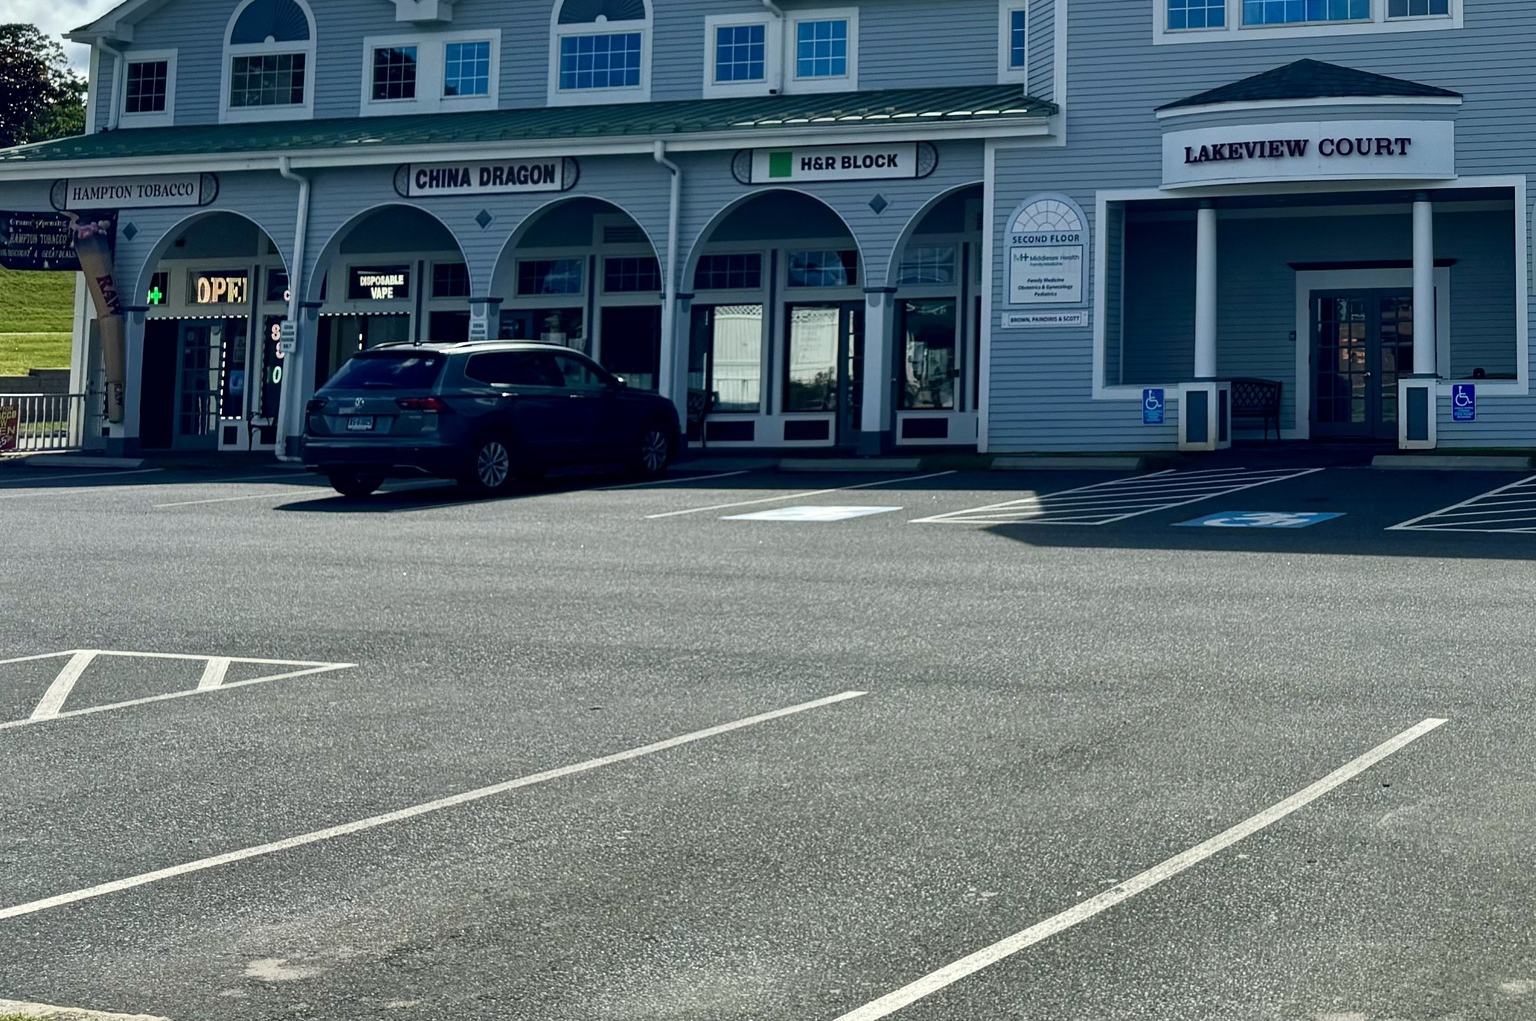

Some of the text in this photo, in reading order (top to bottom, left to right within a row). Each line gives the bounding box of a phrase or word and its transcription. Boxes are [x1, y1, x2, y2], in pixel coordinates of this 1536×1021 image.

[1184, 137, 1412, 165] LAKEVIEW COURT
[801, 154, 898, 171] H&R BLOCK
[415, 164, 556, 189] CHINA DRAGON
[72, 182, 194, 201] HAMPTON TOBACCO
[1012, 234, 1080, 244] SECOND FLOOR
[360, 274, 404, 287] DISPOSABLE
[96, 274, 125, 315] RAW
[197, 277, 248, 304] OPE
[370, 286, 394, 299] VAPE
